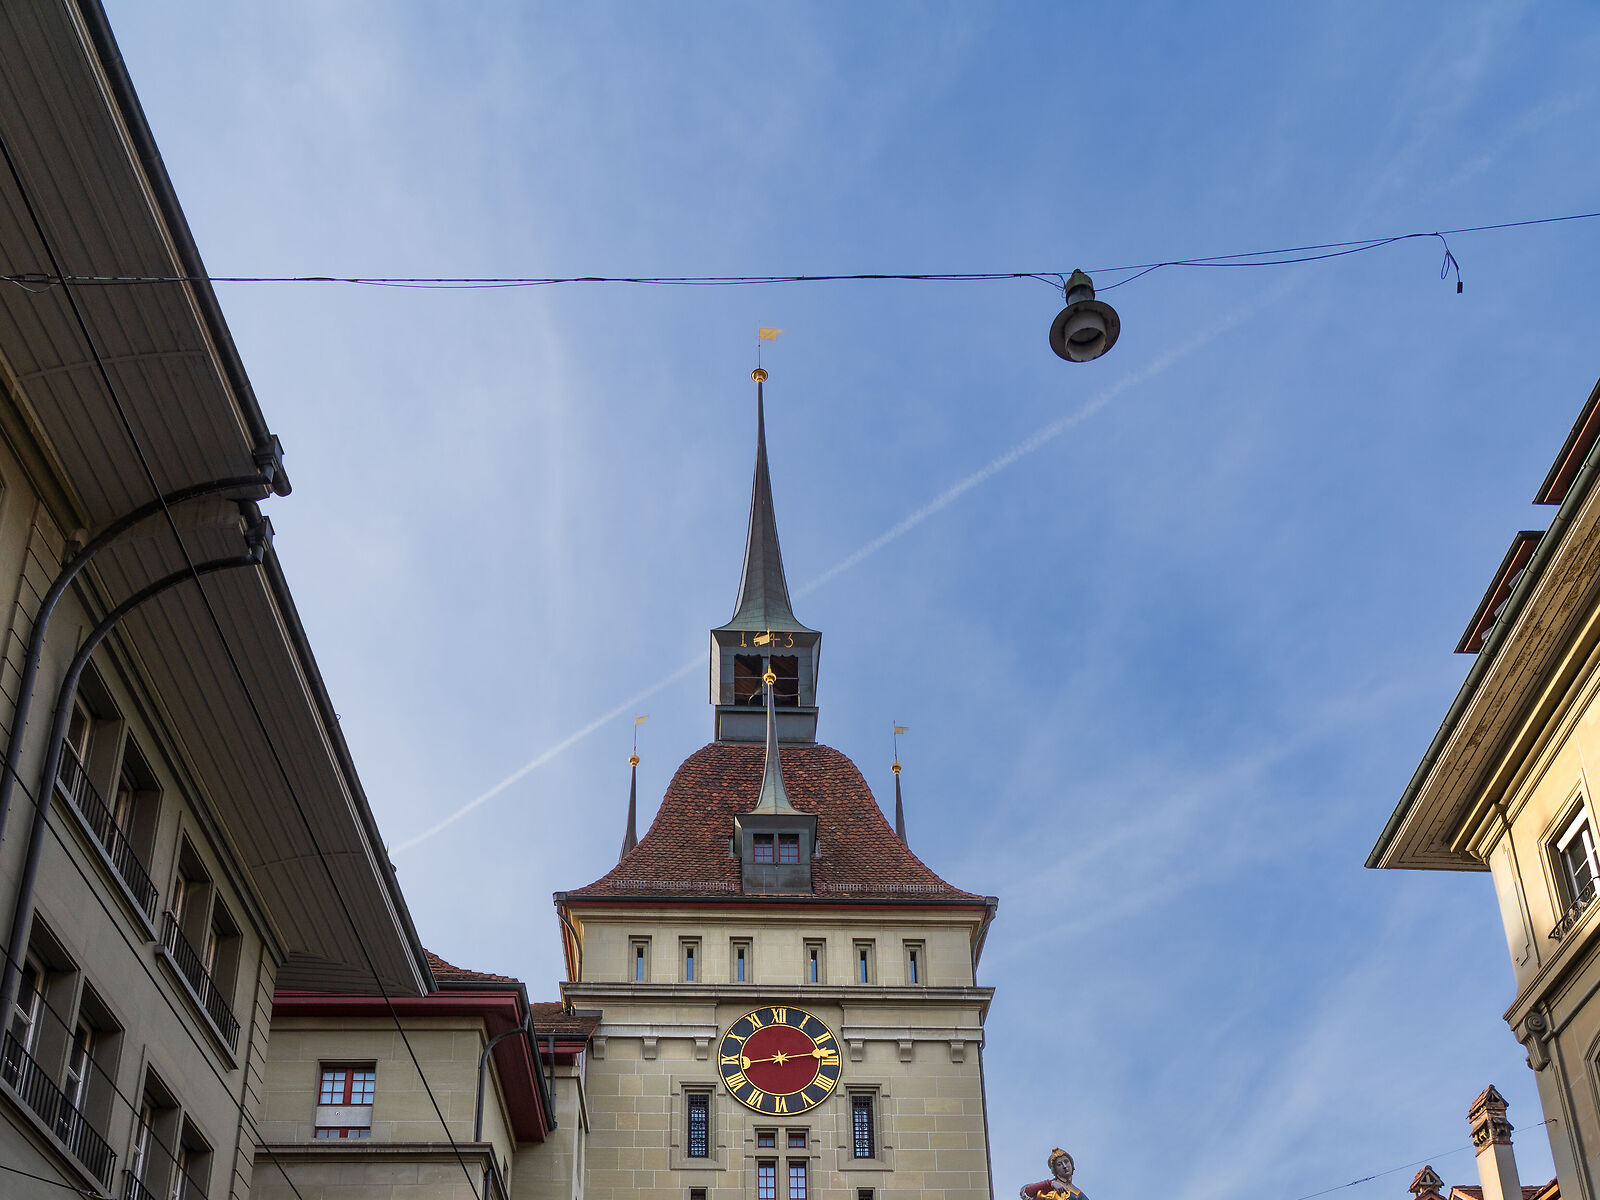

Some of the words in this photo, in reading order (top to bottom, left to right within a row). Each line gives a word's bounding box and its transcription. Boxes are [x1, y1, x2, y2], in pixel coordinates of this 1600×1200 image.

[745, 1012, 763, 1031] XI
[771, 1008, 787, 1024] XII
[799, 1014, 811, 1030] I
[727, 1030, 747, 1045] X
[814, 1031, 832, 1044] II
[721, 1054, 739, 1066] IX
[821, 1055, 839, 1066] III
[725, 1071, 747, 1093] VIII
[813, 1073, 835, 1092] IIII
[746, 1089, 764, 1109] VII
[775, 1096, 788, 1113] VI
[801, 1091, 815, 1108] V
